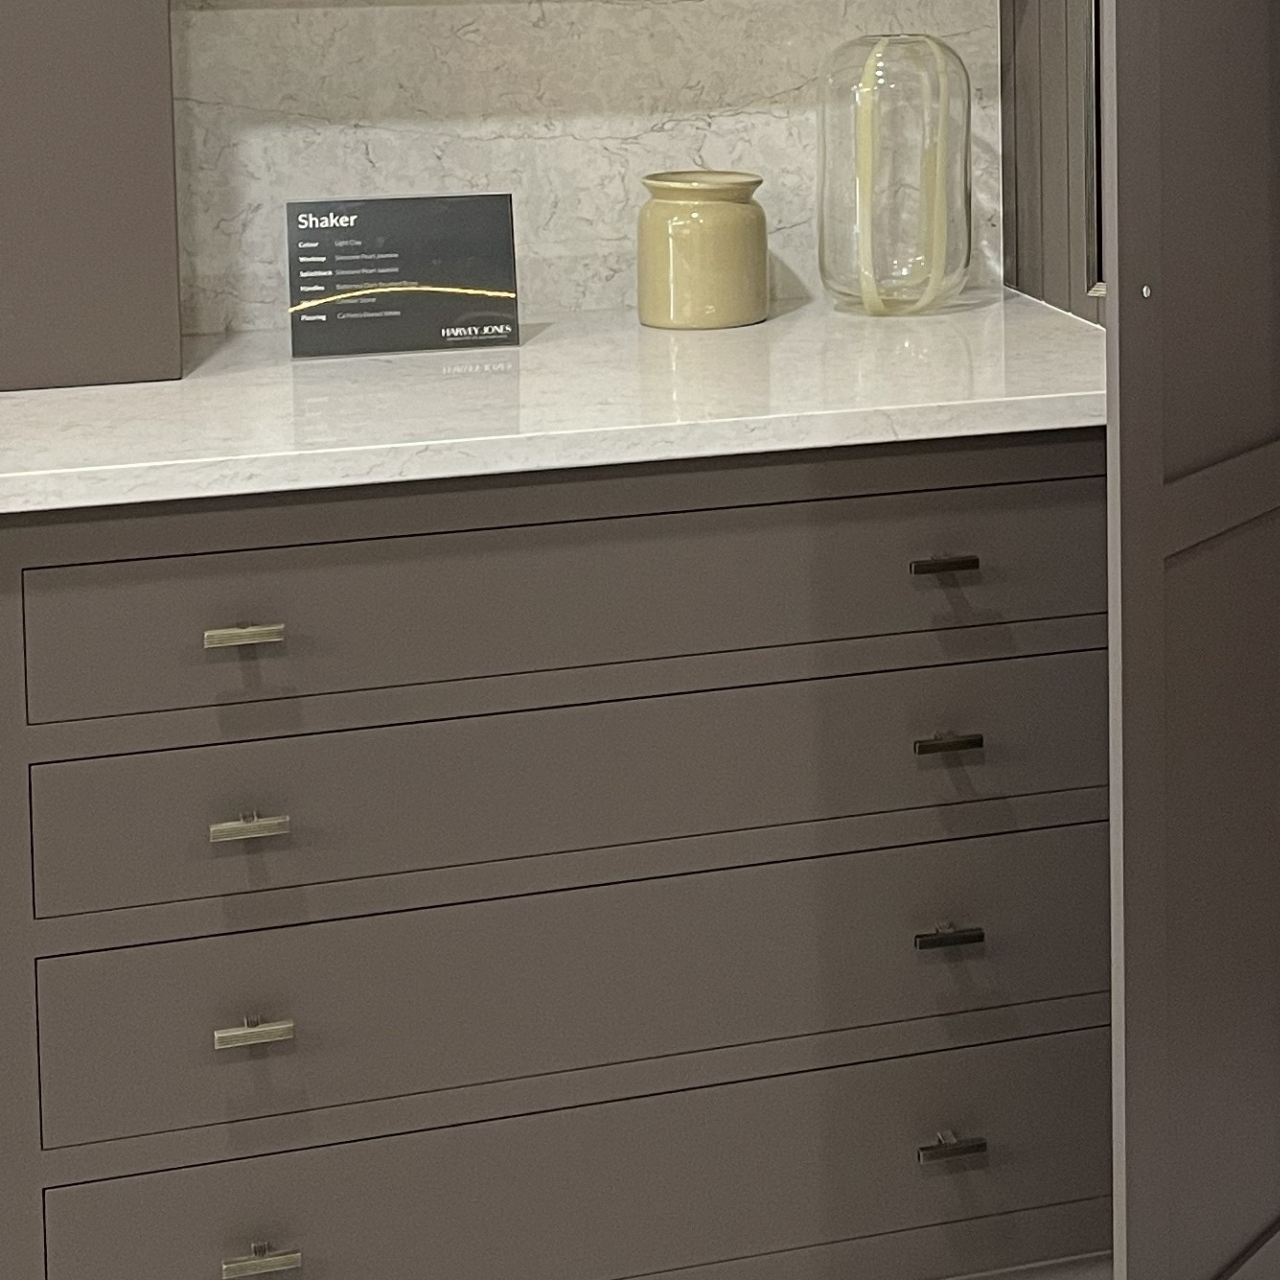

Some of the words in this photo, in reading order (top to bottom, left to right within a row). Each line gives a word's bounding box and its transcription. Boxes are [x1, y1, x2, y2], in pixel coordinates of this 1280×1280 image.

[298, 212, 358, 229] Shaker
[441, 325, 480, 337] HARVEY
[481, 324, 512, 334] JONES
